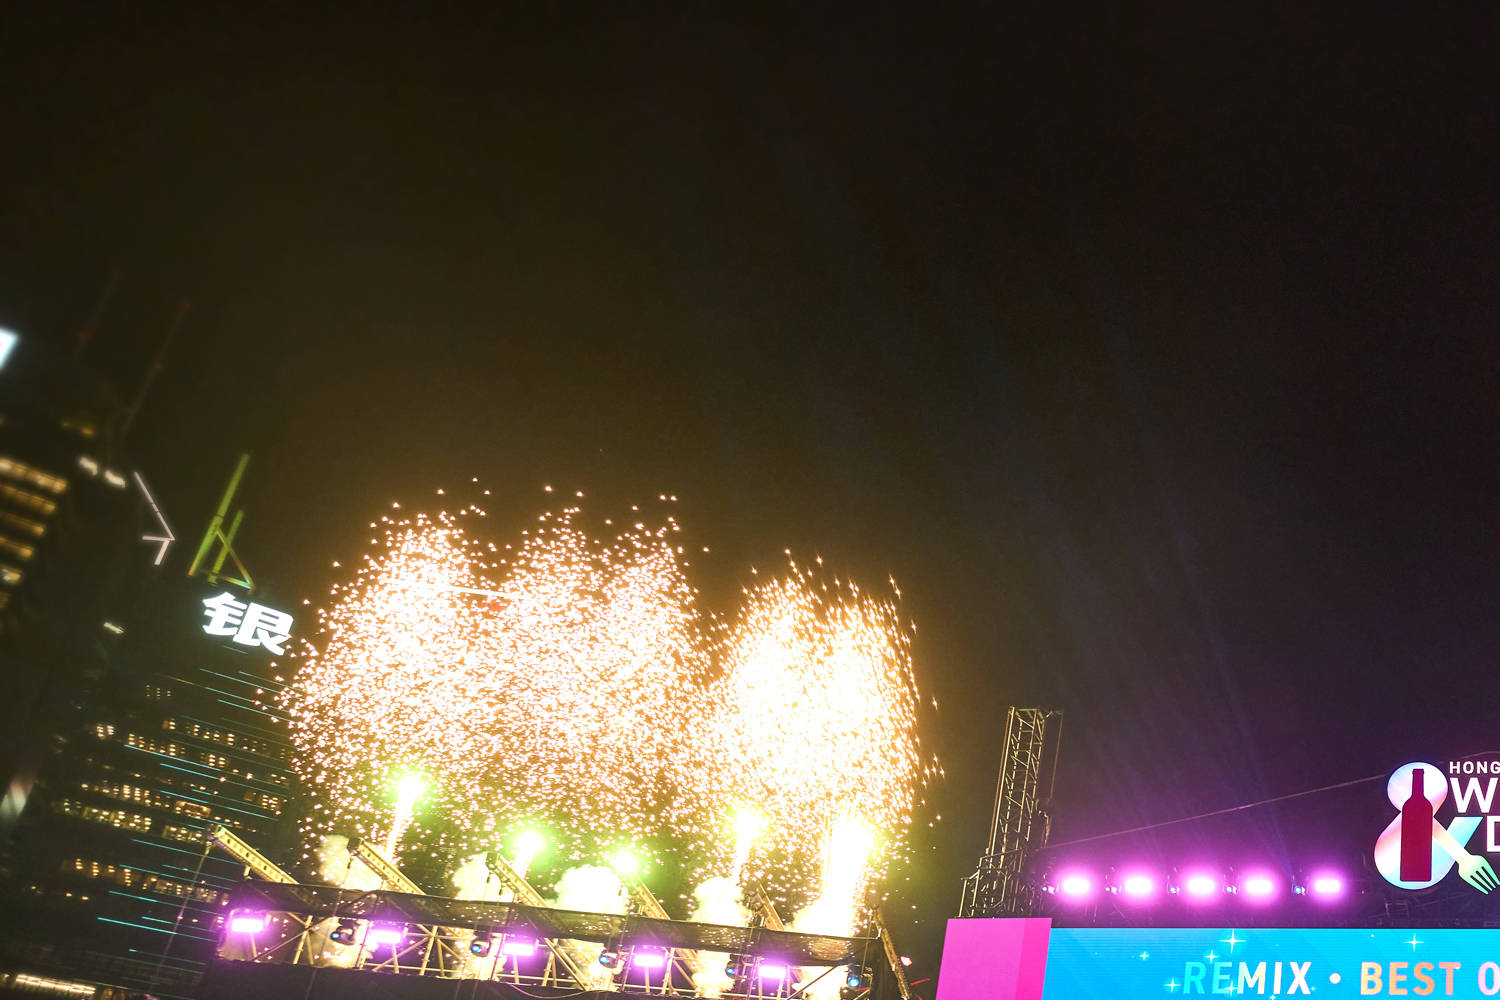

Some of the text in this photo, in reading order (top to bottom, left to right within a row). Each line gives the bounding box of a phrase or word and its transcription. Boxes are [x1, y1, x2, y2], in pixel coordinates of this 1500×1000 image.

[202, 591, 294, 656] 银
[1183, 961, 1312, 995] REMIX
[1360, 961, 1462, 996] BEST
